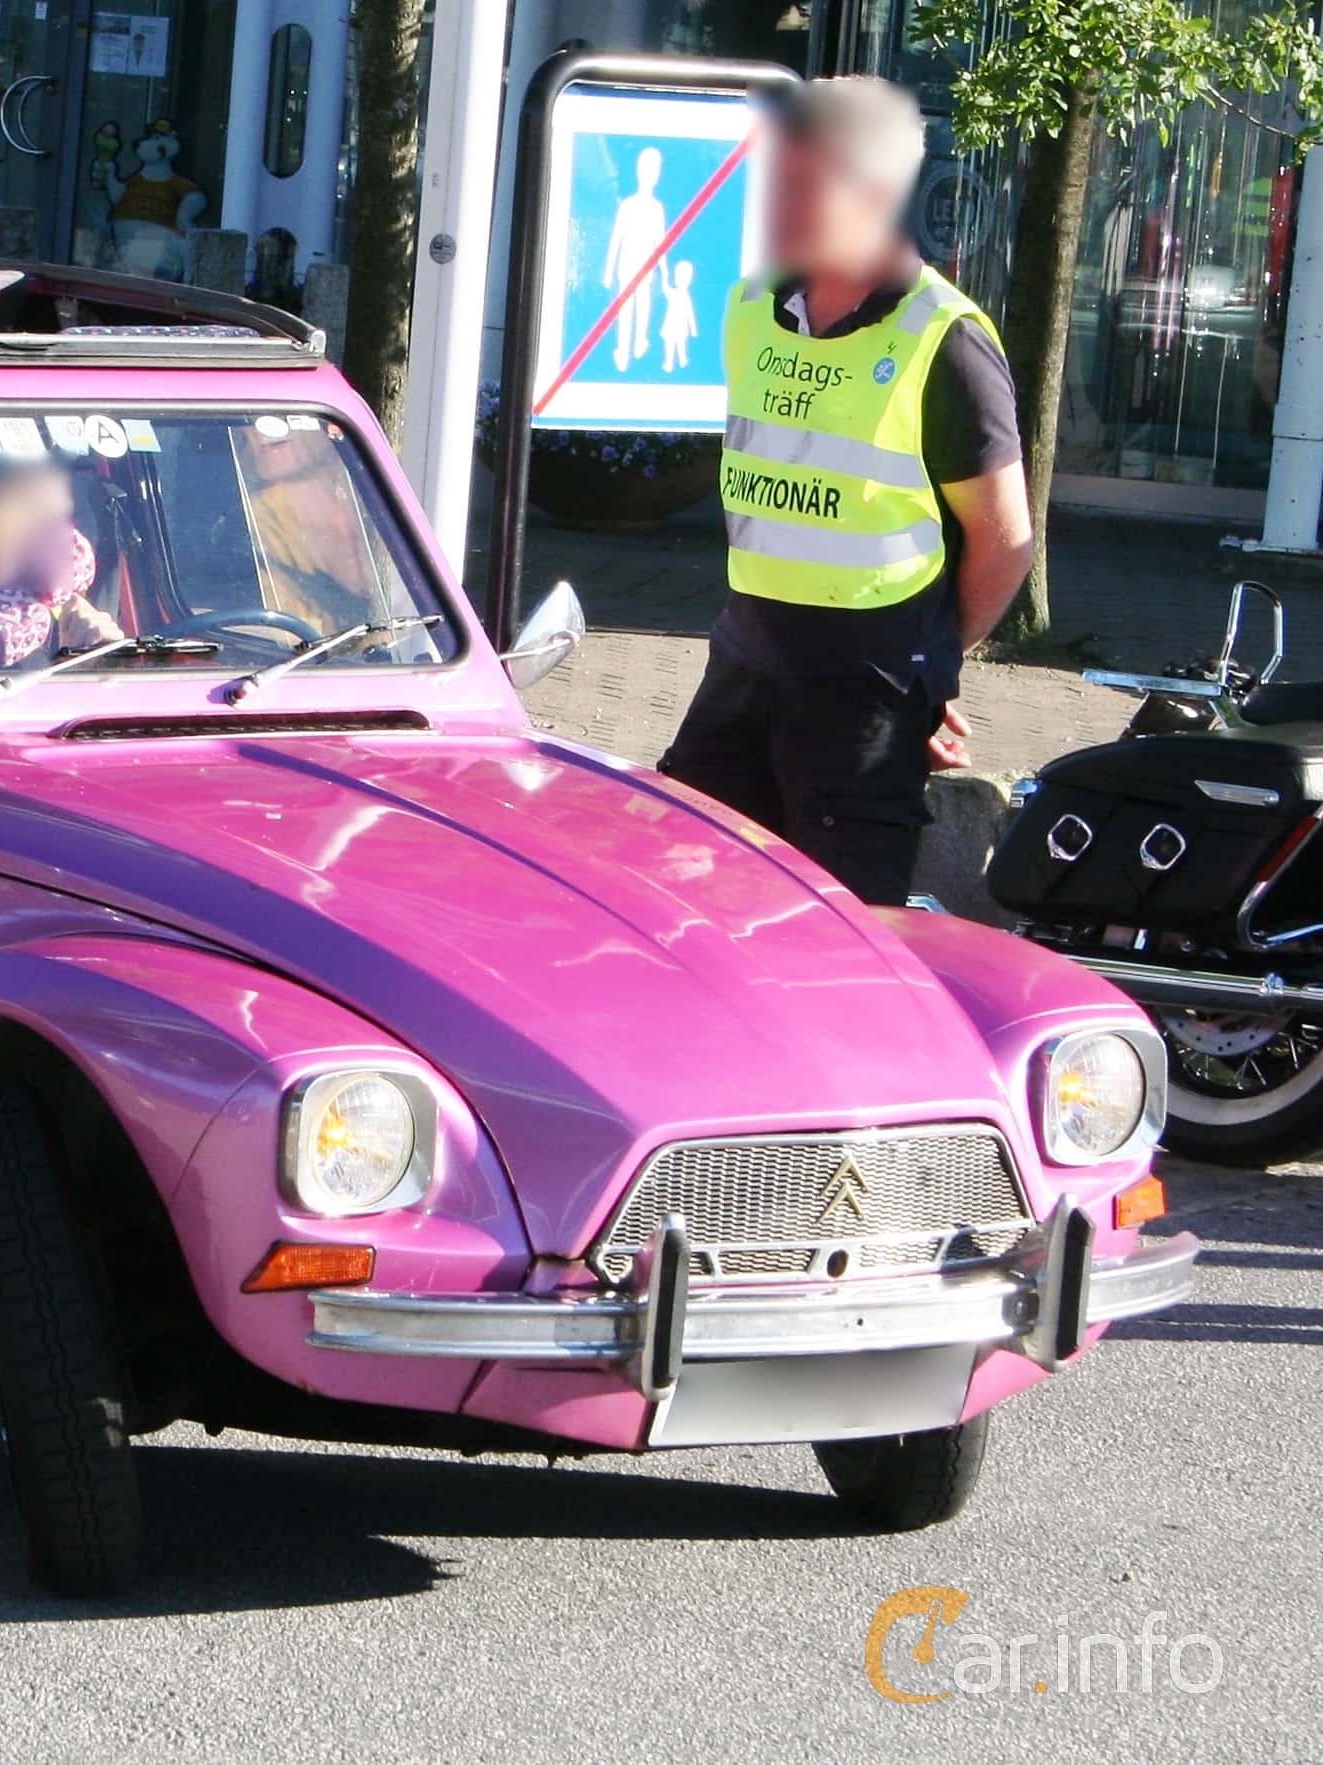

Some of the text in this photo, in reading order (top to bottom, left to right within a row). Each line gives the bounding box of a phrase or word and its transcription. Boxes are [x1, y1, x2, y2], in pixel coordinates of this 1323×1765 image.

[757, 346, 853, 391] Onsdags-
[762, 389, 815, 420] träff
[97, 421, 119, 444] A
[722, 466, 840, 518] FUNKTIONÄR
